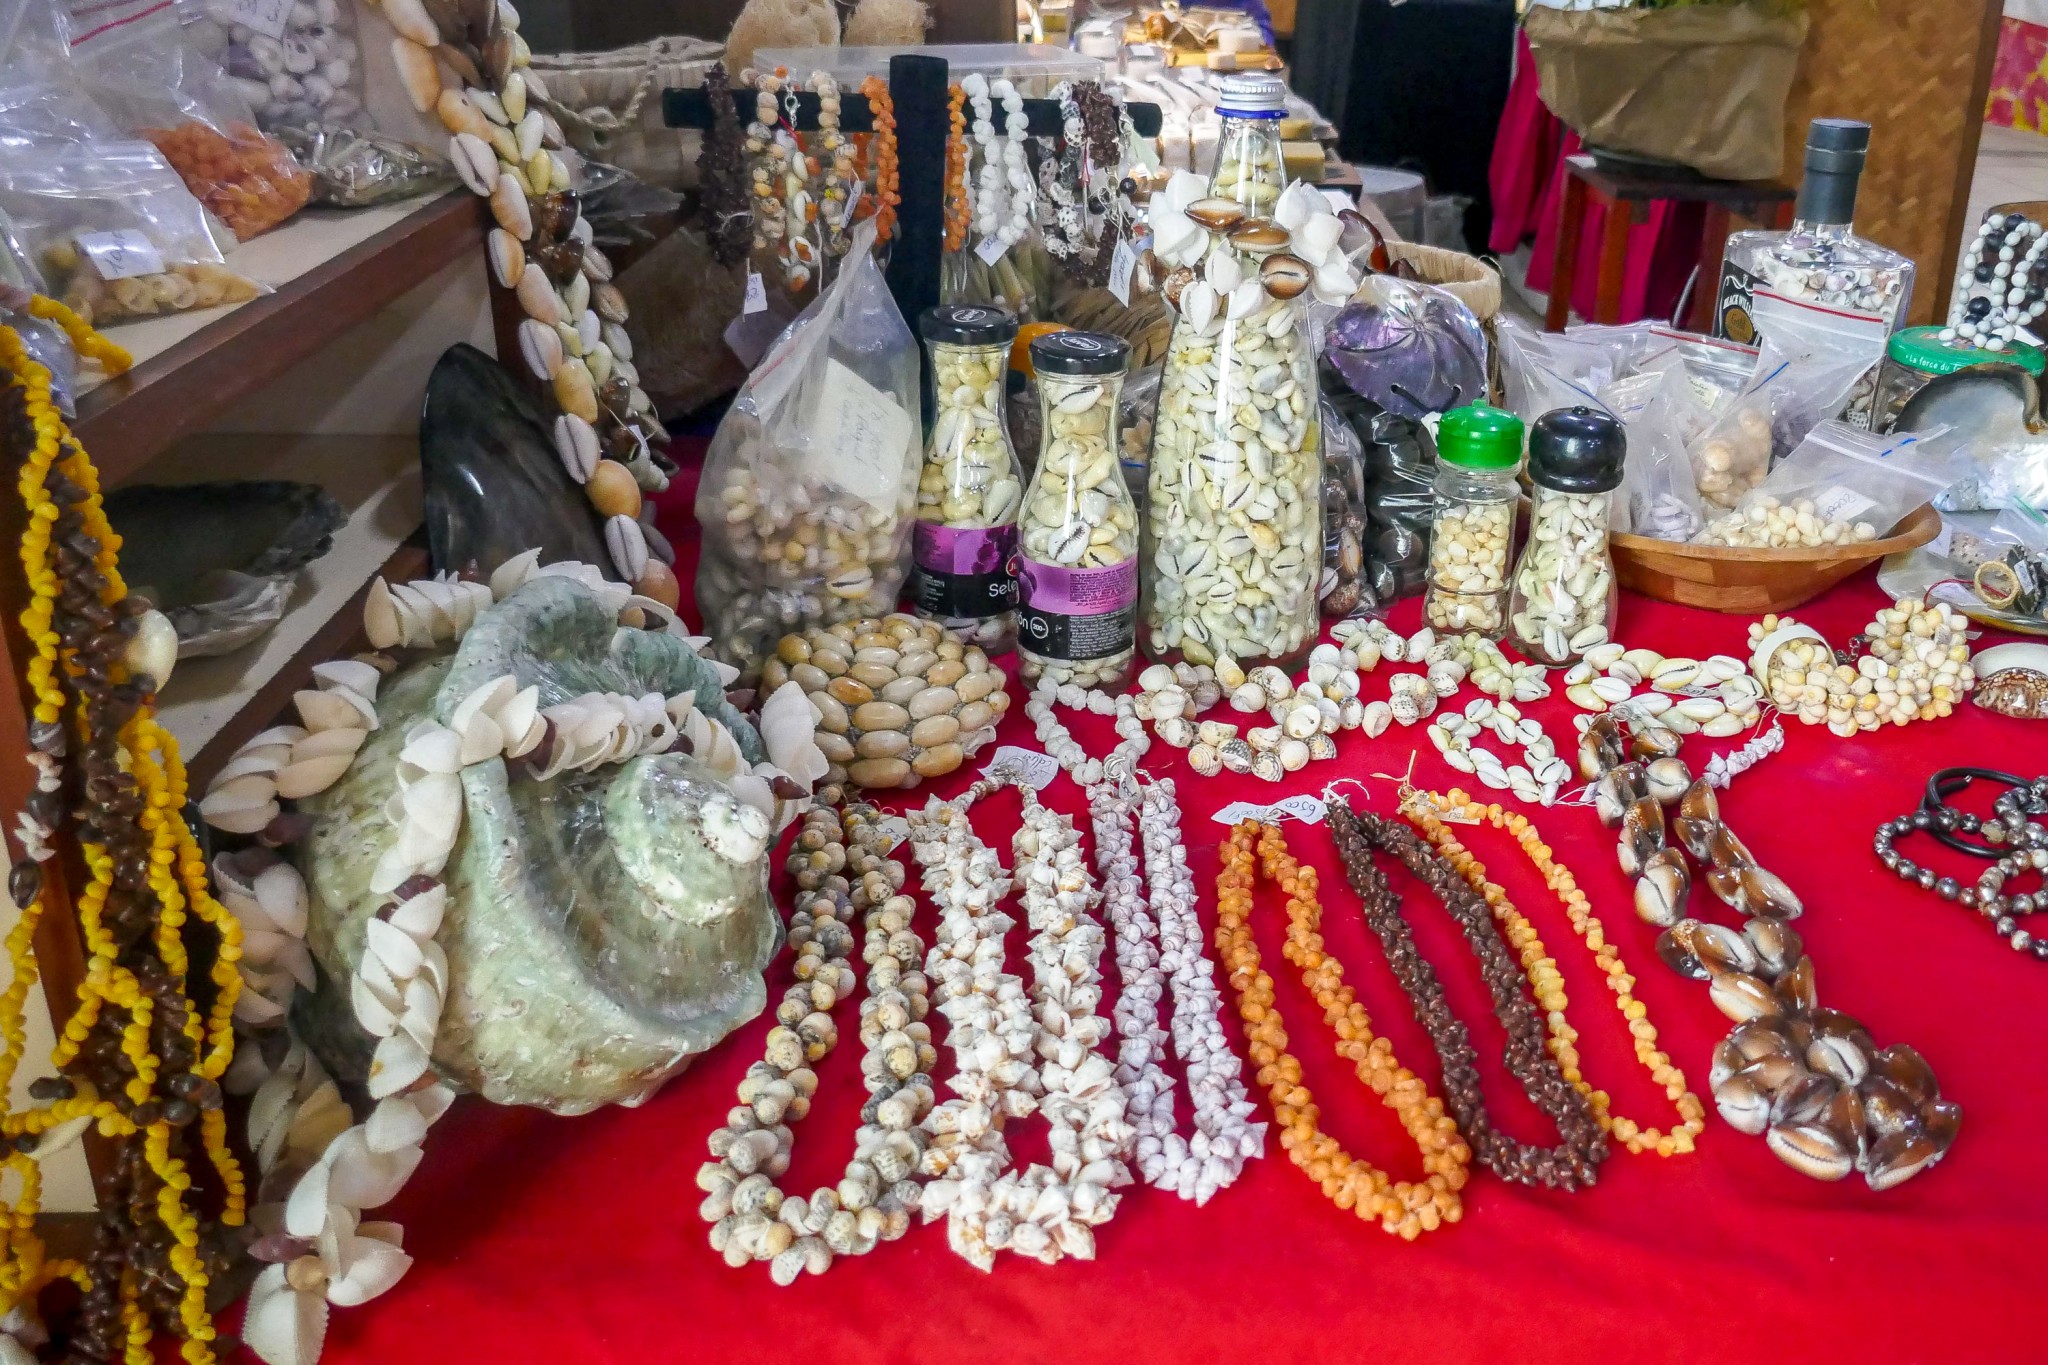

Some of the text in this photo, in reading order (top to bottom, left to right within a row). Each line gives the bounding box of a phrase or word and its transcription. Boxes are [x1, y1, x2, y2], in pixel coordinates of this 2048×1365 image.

[1909, 354, 1917, 364] La
[1919, 357, 1938, 369] force
[1940, 363, 1950, 371] du
